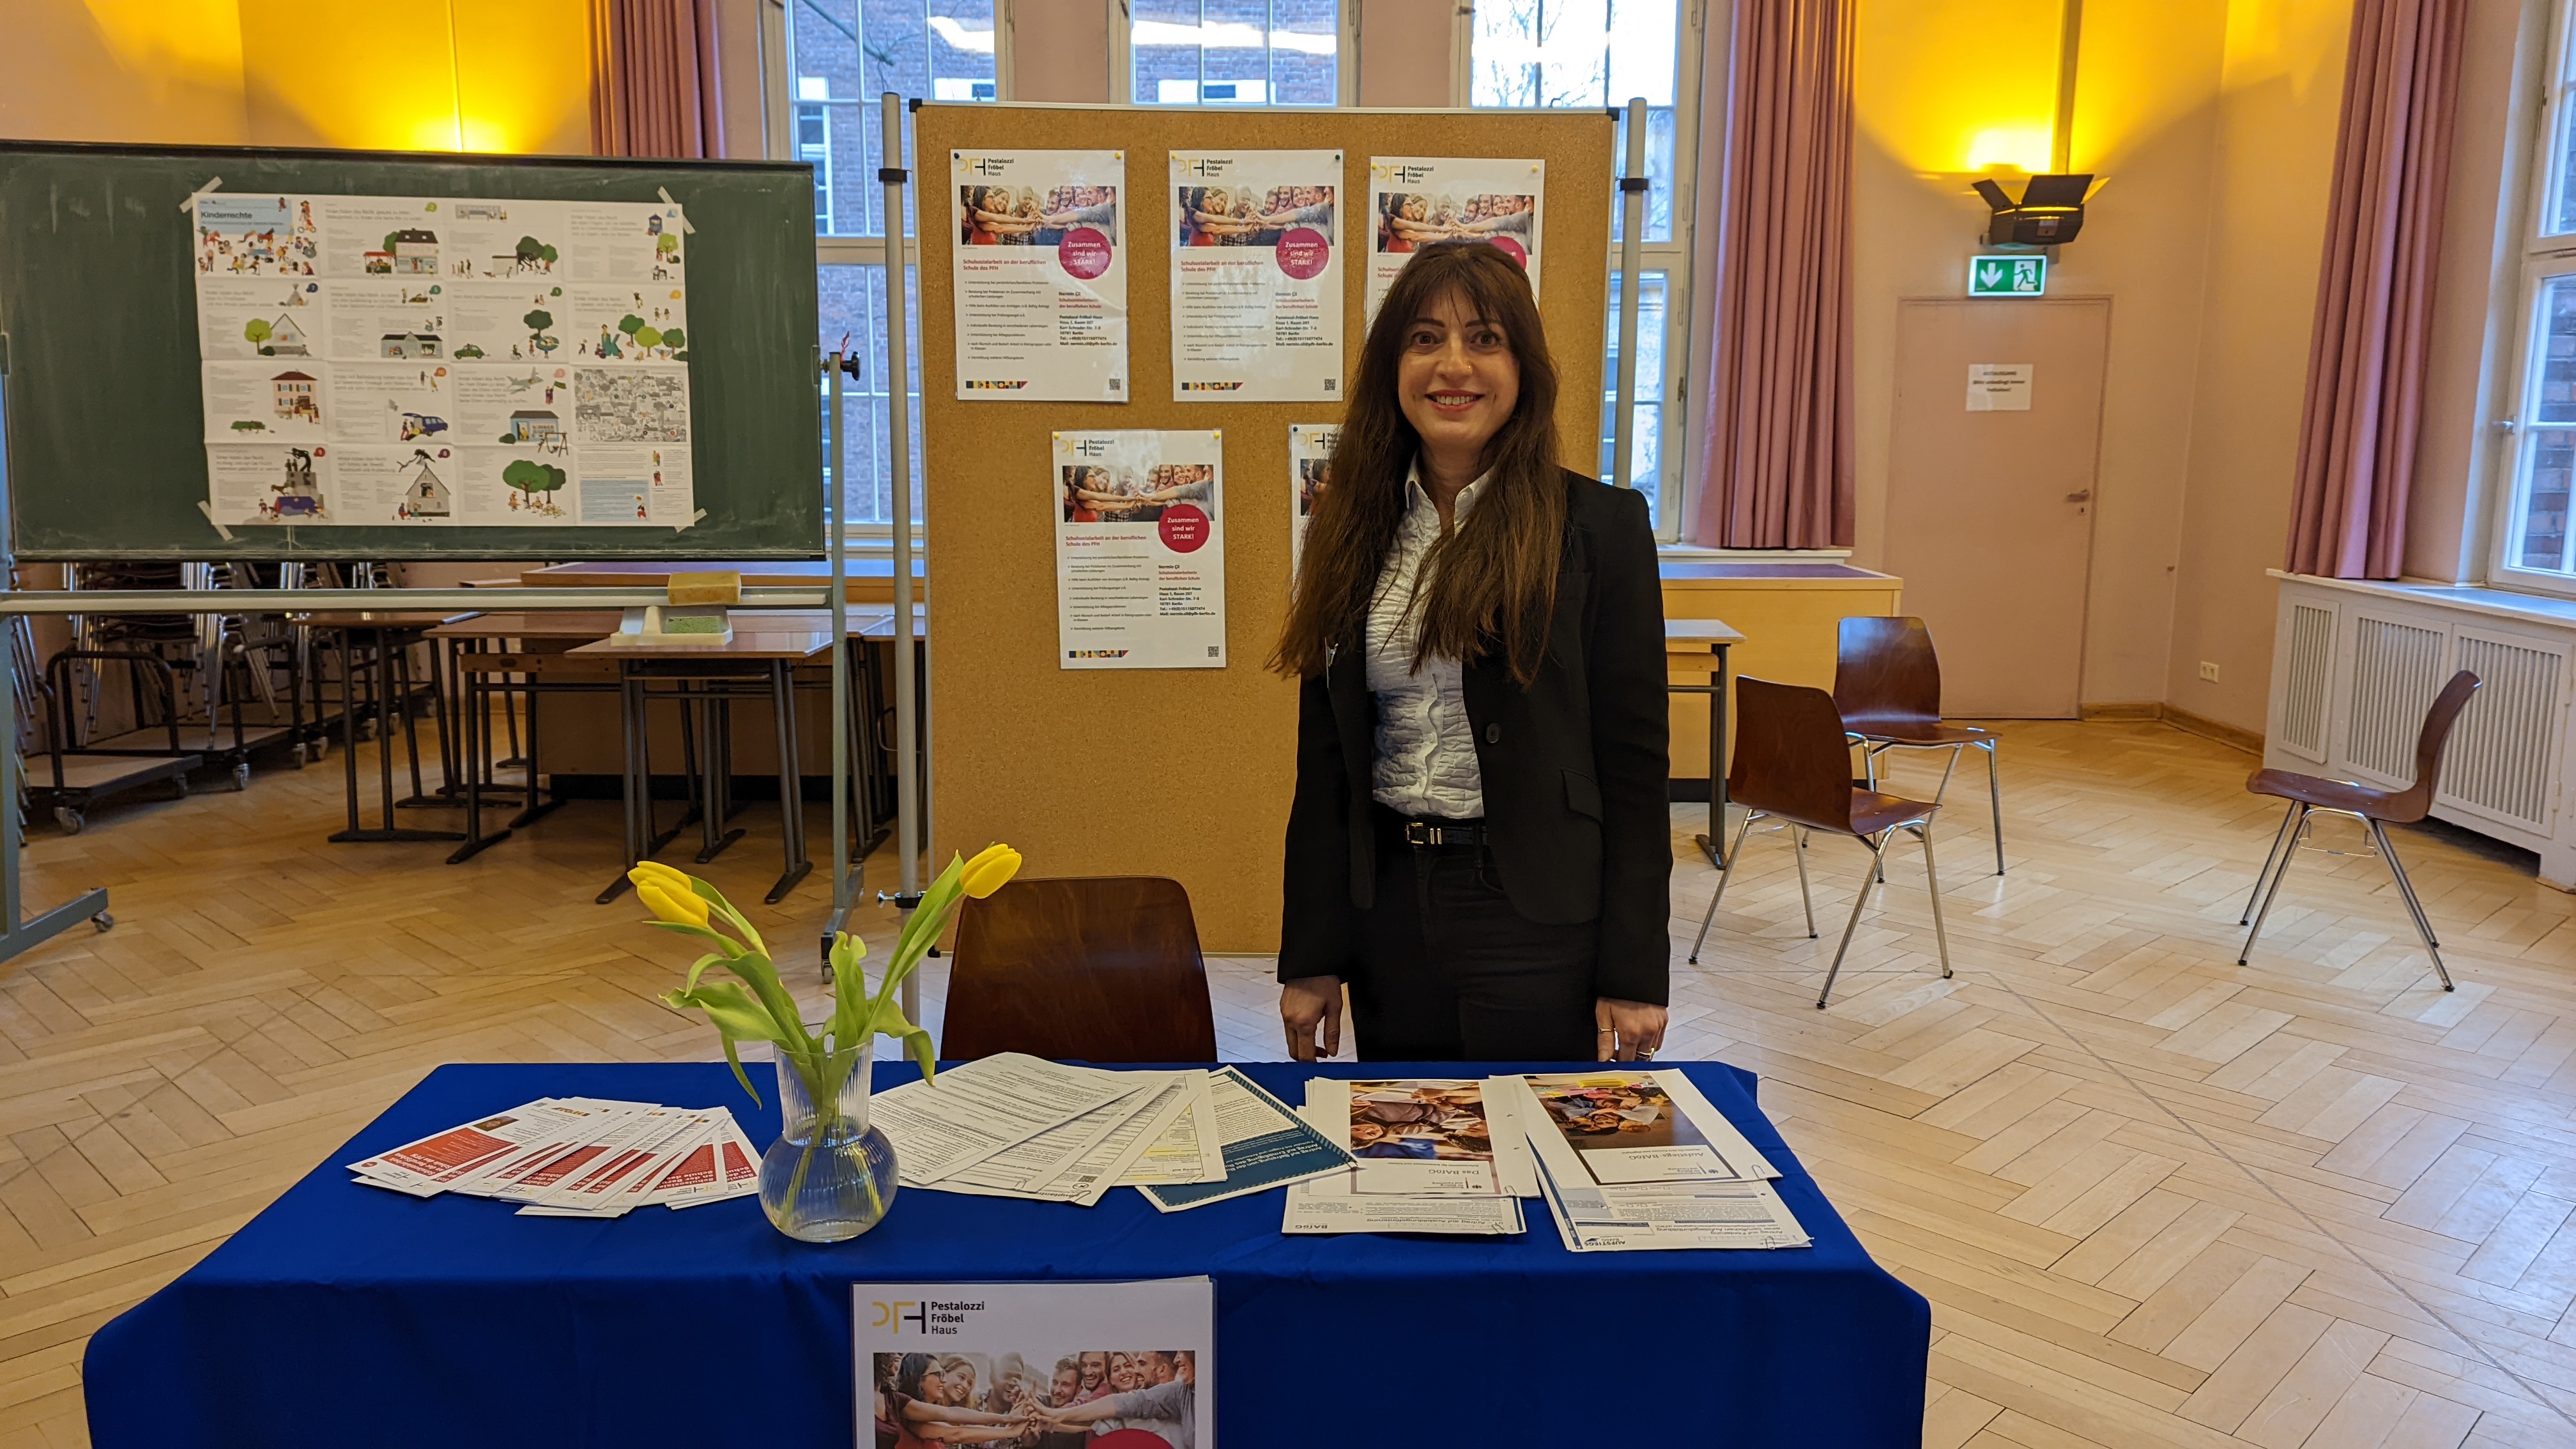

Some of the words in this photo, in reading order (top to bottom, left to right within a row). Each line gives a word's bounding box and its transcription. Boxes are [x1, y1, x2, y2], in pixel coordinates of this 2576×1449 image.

[1300, 1146, 1322, 1154] Antrag
[1629, 1152, 1704, 1160] Aufstiegs-BAföG
[659, 1177, 714, 1188] Schulsoziala
[931, 1301, 985, 1311] Pestalozzi
[931, 1313, 965, 1323] Fröbel
[931, 1325, 958, 1335] Haus
